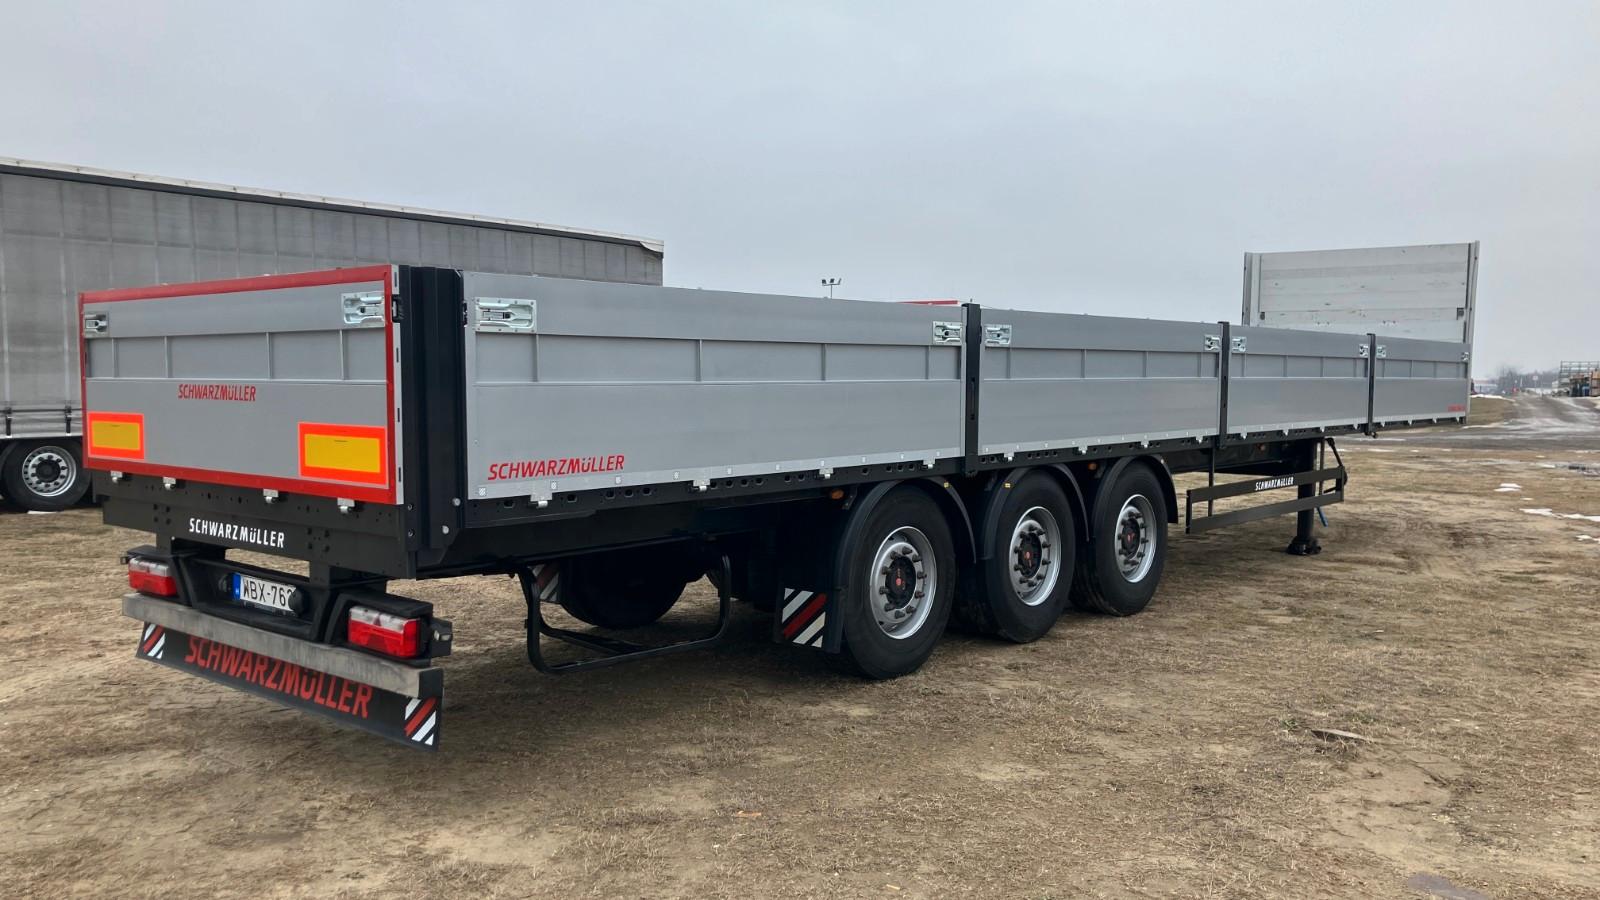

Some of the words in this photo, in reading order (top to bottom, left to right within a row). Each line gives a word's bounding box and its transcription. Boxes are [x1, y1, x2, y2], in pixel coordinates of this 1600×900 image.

[178, 384, 256, 402] SCHWARZMÜLLER
[488, 455, 625, 480] SCHWARZMÜLLER
[1255, 476, 1294, 491] SCHWARZMÜLLER
[189, 518, 285, 548] SCHWARZMÜLLER
[184, 636, 373, 718] SCHWARZMÜLLER
